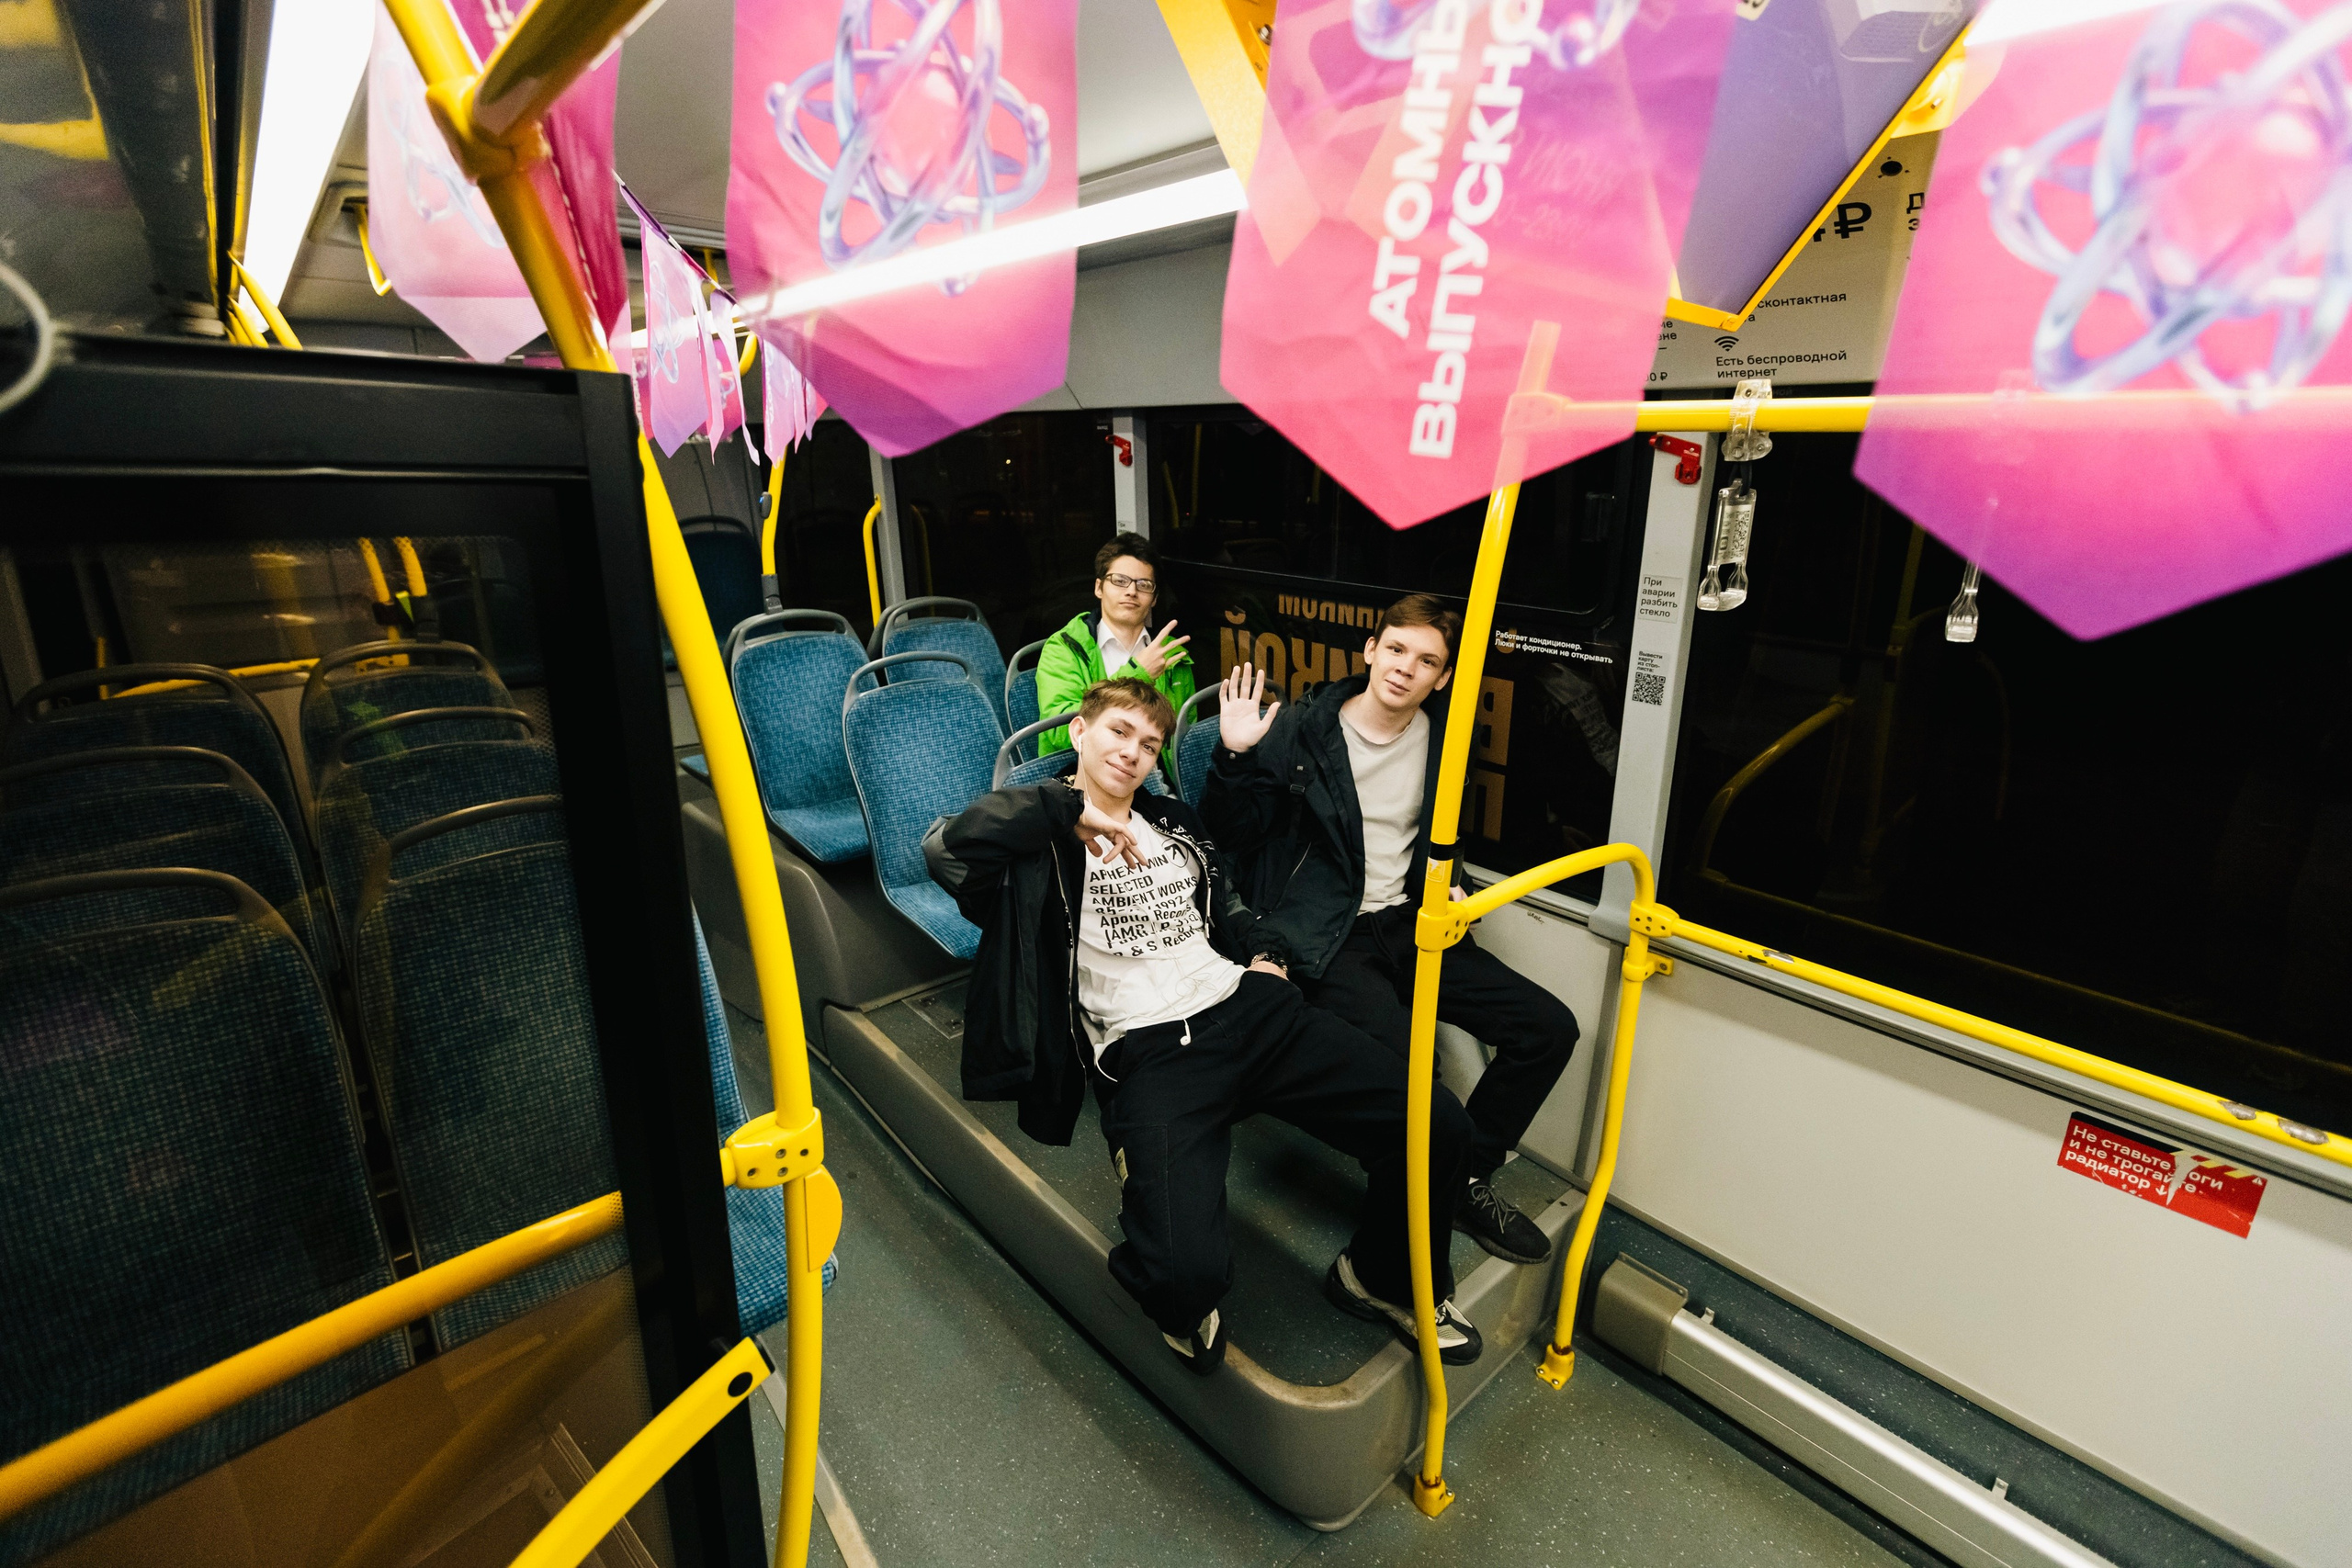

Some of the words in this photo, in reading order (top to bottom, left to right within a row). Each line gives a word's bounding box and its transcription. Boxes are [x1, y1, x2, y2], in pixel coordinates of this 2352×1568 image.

[1757, 293, 1847, 310] сконтактная
[1715, 355, 1744, 367] Есть
[1747, 350, 1847, 366] беспроводной
[1717, 367, 1778, 379] интернет
[1644, 576, 1662, 587] При
[1642, 588, 1676, 598] аварии
[1641, 598, 1678, 608] разбить
[1639, 607, 1670, 617] стекло
[1495, 629, 1528, 642] Работает
[1529, 636, 1583, 650] кондиционер.
[1495, 637, 1515, 649] Люки
[1515, 641, 1521, 649] и
[1521, 643, 1558, 656] форточки
[1560, 649, 1570, 658] не
[1571, 650, 1613, 664] открывать
[1090, 865, 1135, 882] APHEX
[1090, 875, 1154, 895] SELECTED
[1092, 889, 1156, 908] AMBIENT
[1157, 875, 1197, 897] WORKS
[1131, 945, 1144, 956] &
[1147, 941, 1158, 952] S
[2069, 1139, 2081, 1150] и
[2086, 1145, 2108, 1159] не
[2073, 1125, 2098, 1143] Не
[2101, 1138, 2172, 1170] ставьте
[2187, 1170, 2224, 1191] оги
[2065, 1150, 2151, 1190] радиатор
